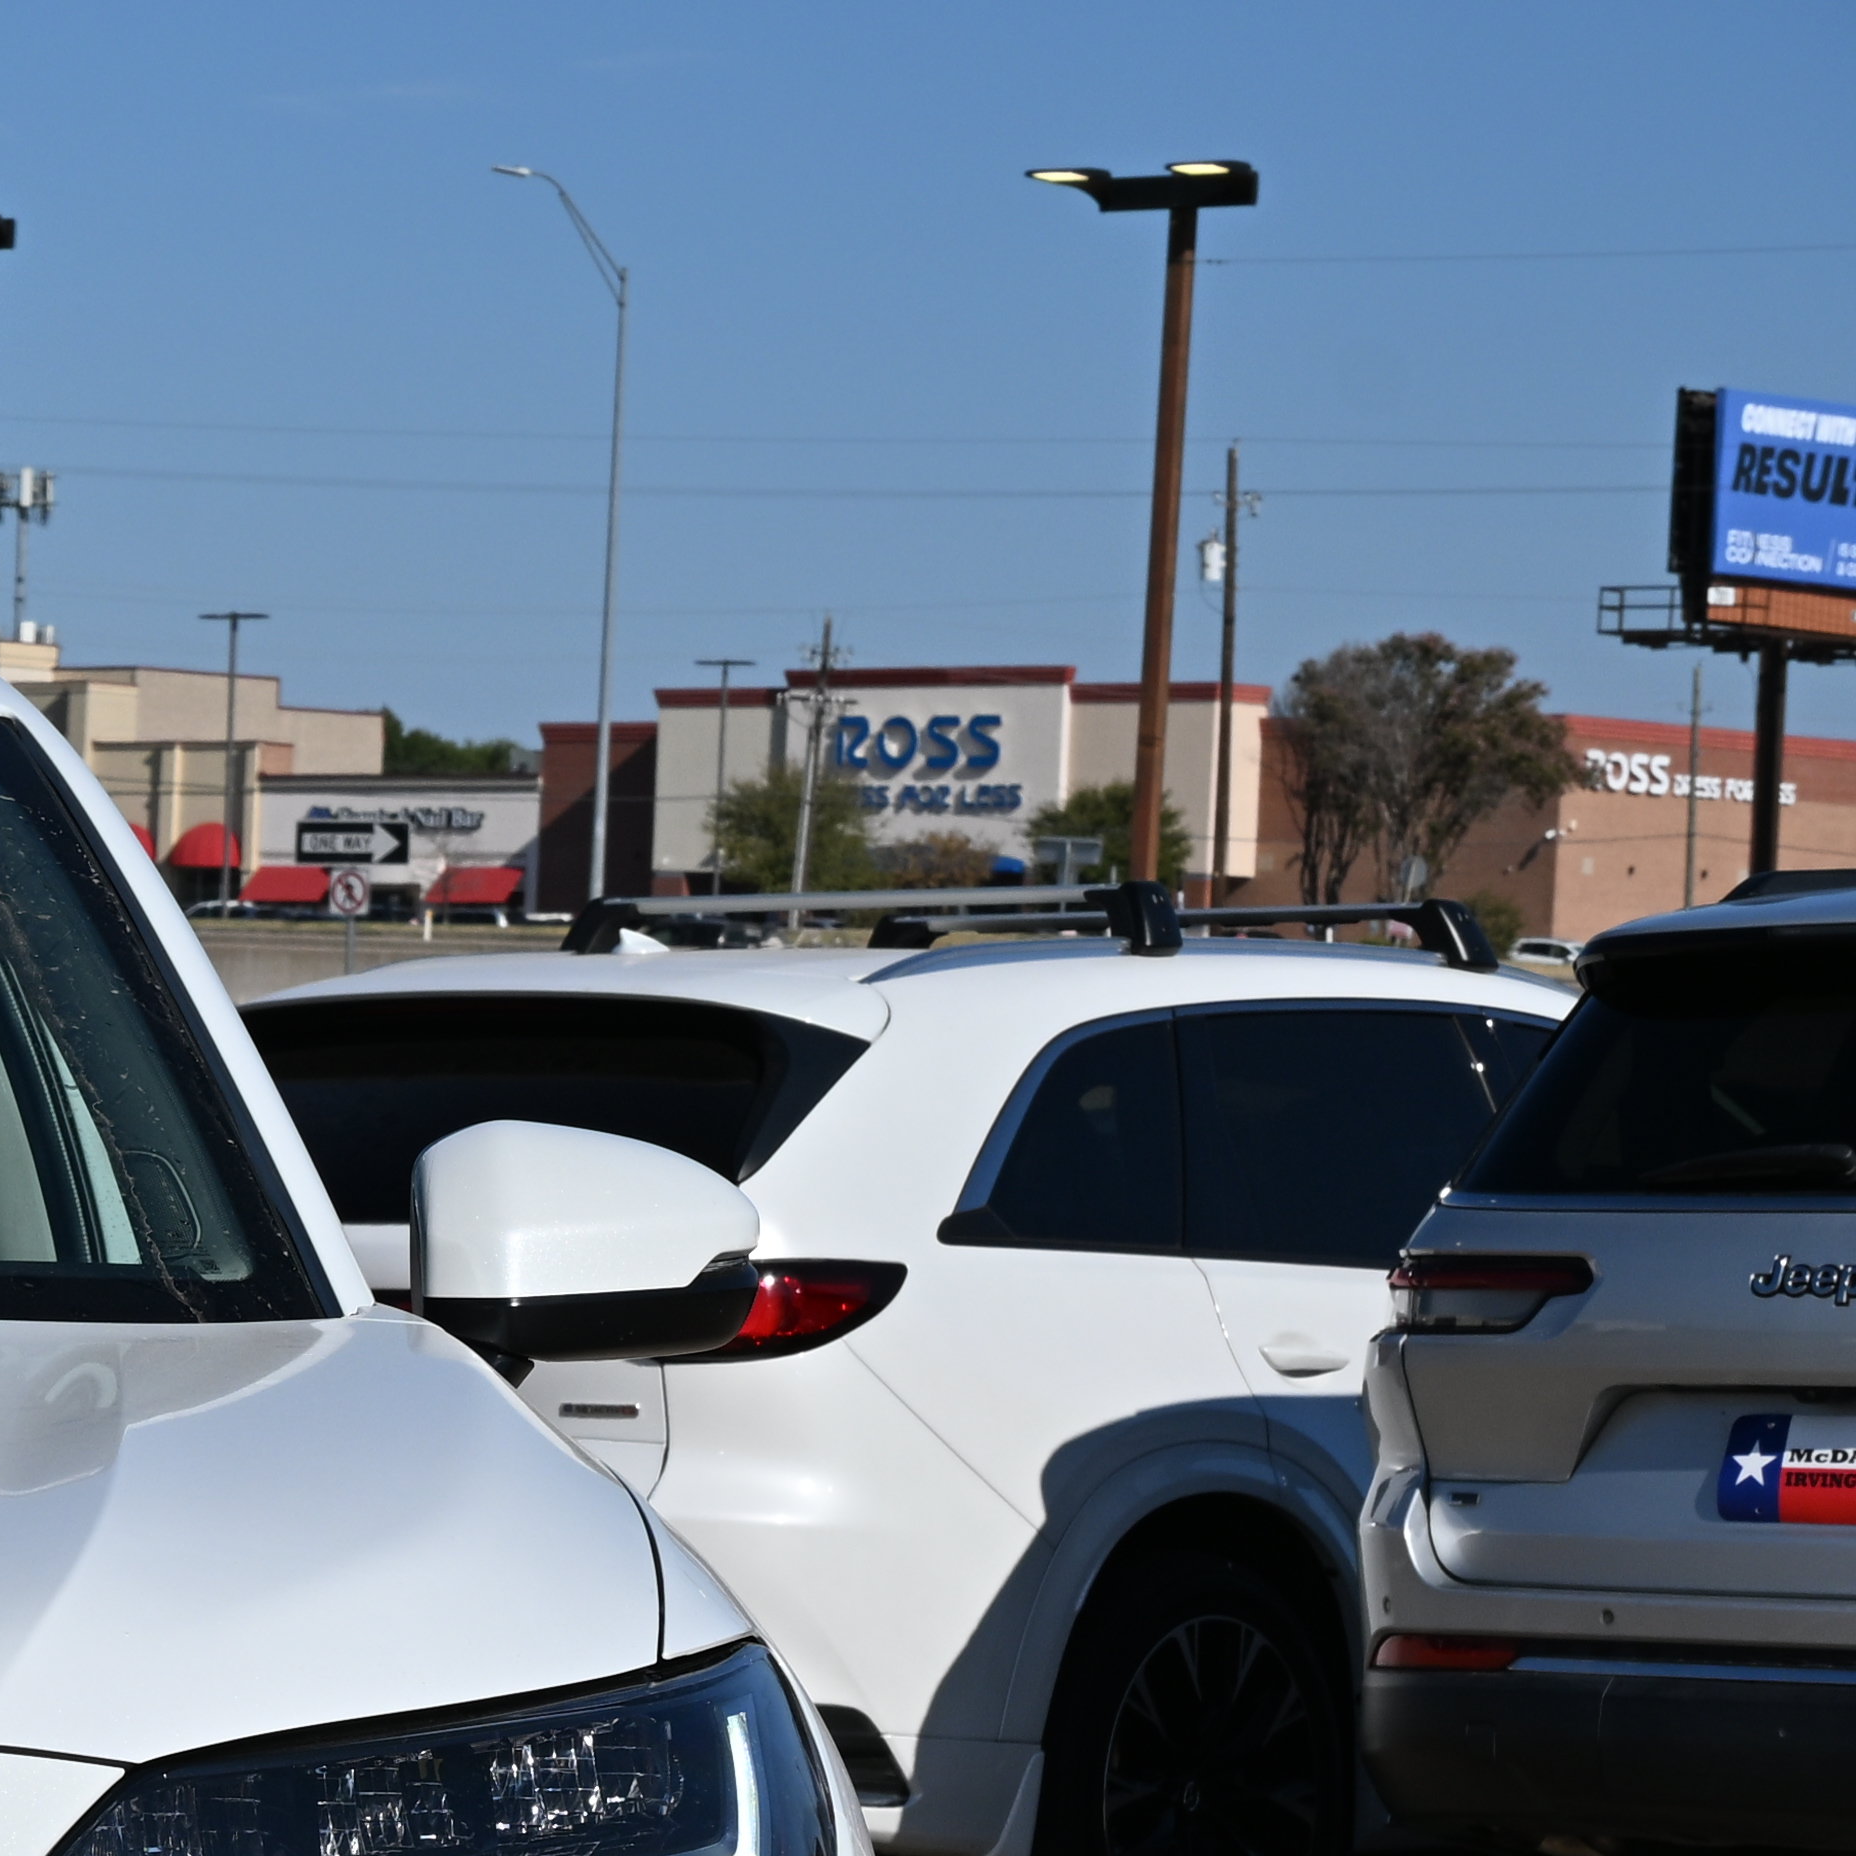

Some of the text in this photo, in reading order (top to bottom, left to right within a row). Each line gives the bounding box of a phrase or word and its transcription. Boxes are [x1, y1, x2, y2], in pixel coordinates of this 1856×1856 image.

[1732, 443, 1856, 506] RESUL
[836, 714, 1002, 769] ROSS
[342, 832, 372, 850] WAY
